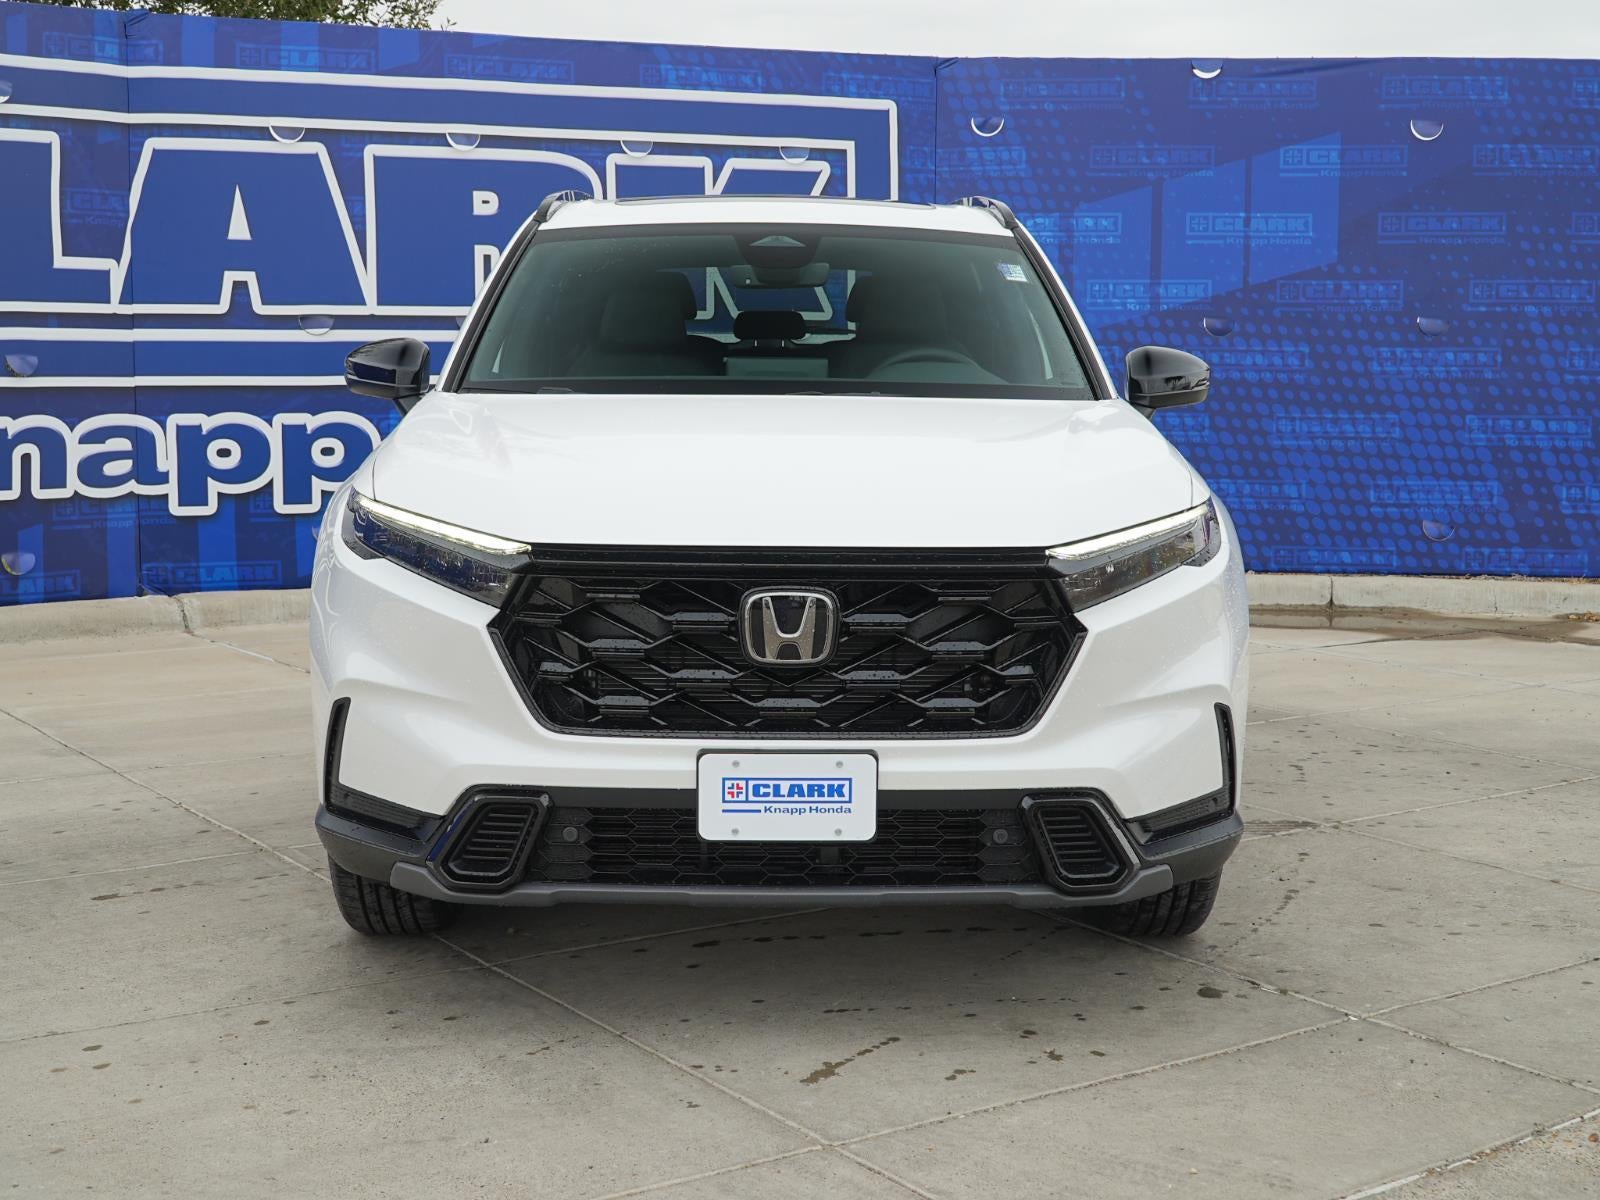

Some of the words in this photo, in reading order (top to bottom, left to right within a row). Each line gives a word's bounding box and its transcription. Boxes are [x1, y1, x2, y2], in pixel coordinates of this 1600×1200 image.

[752, 783, 846, 798] CLARK
[763, 805, 807, 816] Knapp
[809, 805, 852, 814] Honda
